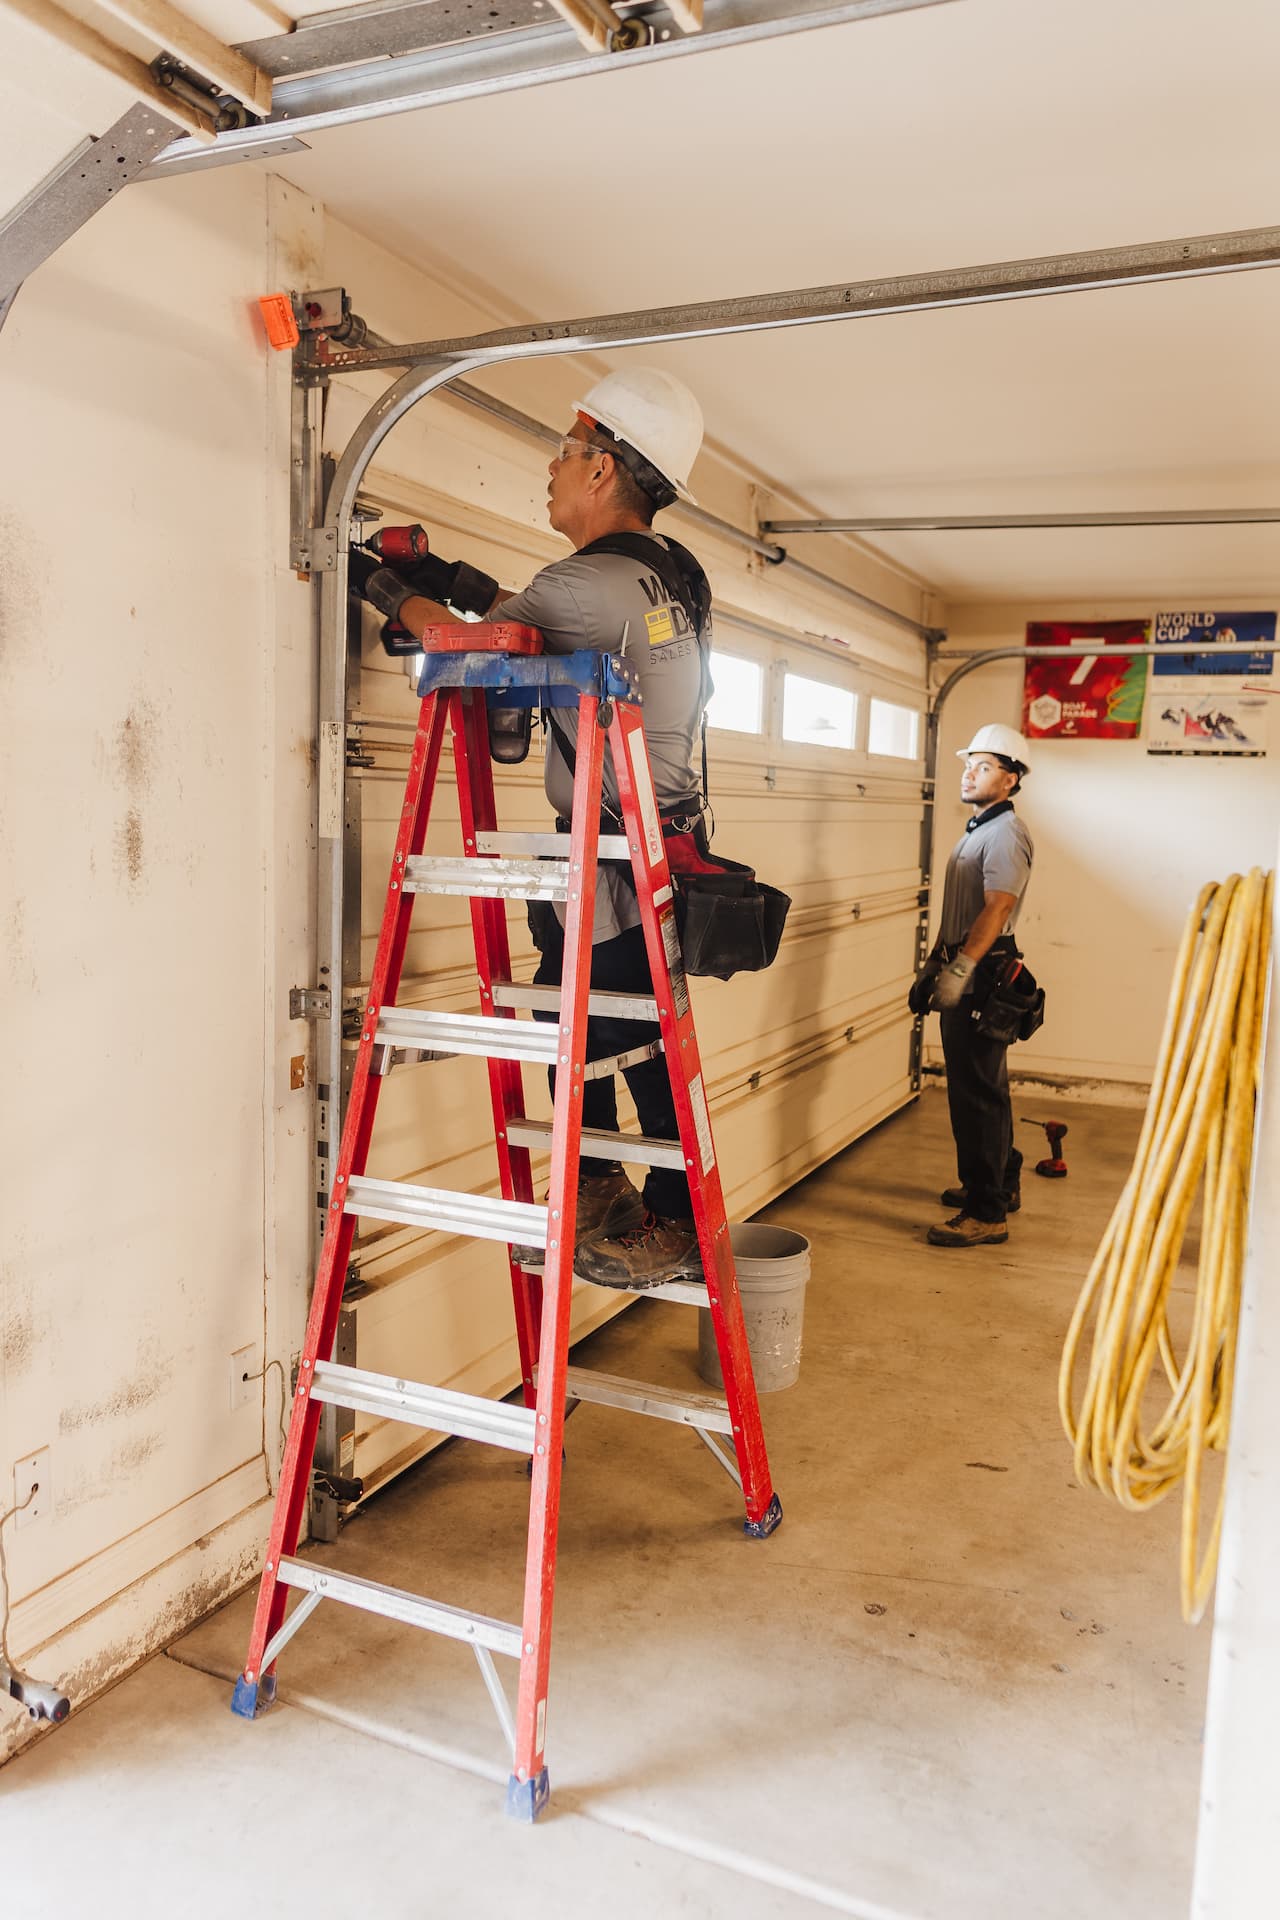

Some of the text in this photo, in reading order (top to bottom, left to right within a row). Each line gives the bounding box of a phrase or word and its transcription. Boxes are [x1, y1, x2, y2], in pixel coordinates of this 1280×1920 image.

[1158, 614, 1215, 627] WORLD
[1157, 627, 1189, 640] CUP
[649, 643, 692, 665] SALES
[1069, 638, 1104, 685] 7
[1062, 701, 1087, 711] BOAT
[1062, 708, 1098, 719] PARADE
